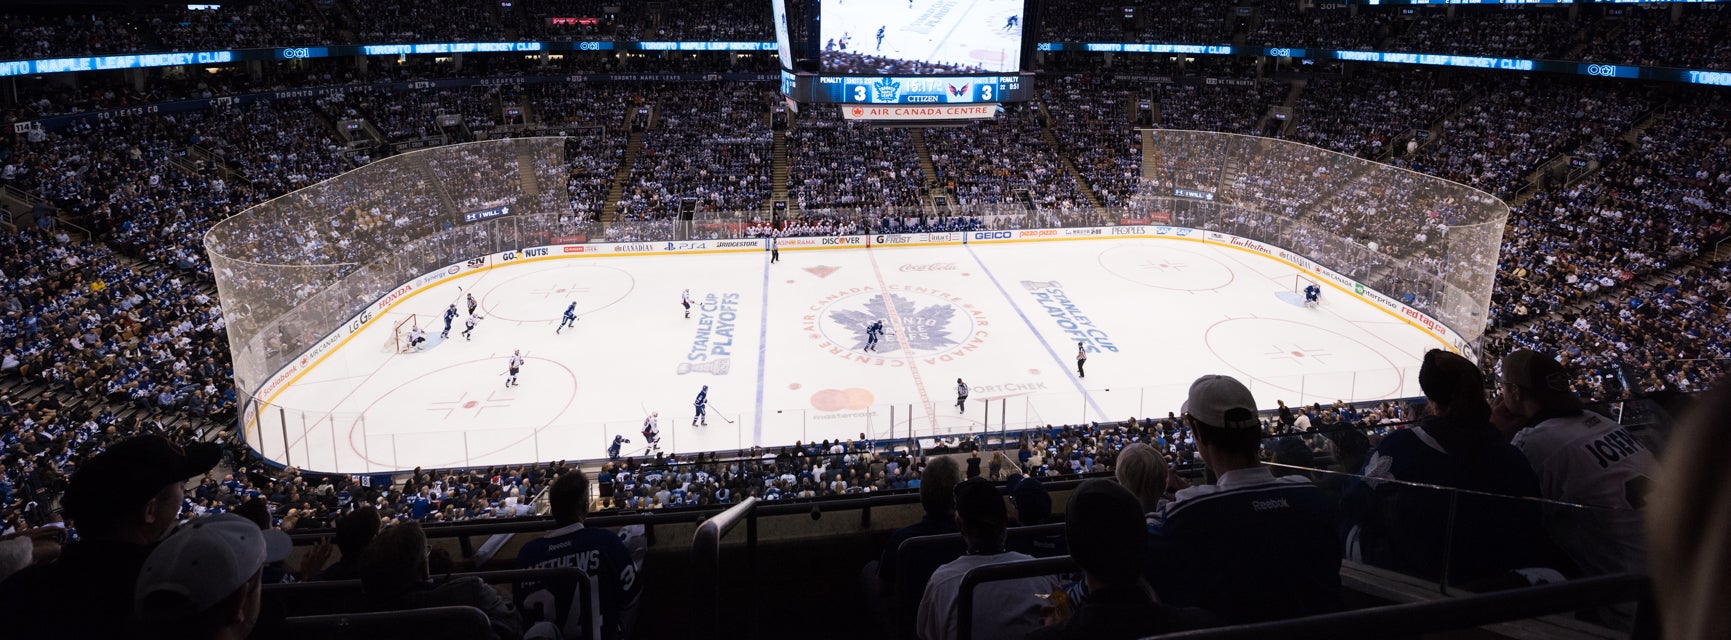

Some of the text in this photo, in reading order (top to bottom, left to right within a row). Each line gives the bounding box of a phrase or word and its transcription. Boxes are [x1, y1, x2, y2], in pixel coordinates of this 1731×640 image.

[364, 42, 540, 54] TORONTO MAPLE LEAF HOCKEY CLUB
[640, 42, 778, 50] TORONTO MAPLE LEAF HOCKEY CLU
[1124, 44, 1150, 52] MAPLE
[1174, 45, 1206, 53] HOCKEY
[1208, 46, 1230, 54] CLUB
[36, 58, 91, 72] MAPLE
[95, 56, 136, 69] LEAF
[139, 53, 194, 66] HOCKEY
[198, 51, 231, 63] CLUB
[1337, 50, 1532, 70] TORONTO MAPLE LEAF HOCKEY CLUB
[854, 86, 866, 101] 3
[982, 85, 992, 100] 3
[16, 123, 30, 132] 114
[975, 231, 1012, 240] GEICO
[1112, 227, 1146, 235] PEOPLES
[1230, 236, 1243, 247] Tim
[1243, 240, 1272, 255] Hortons
[467, 257, 485, 266] SN
[503, 248, 548, 261] GO NUTS!
[898, 262, 958, 272] Coca-Cola
[424, 271, 446, 283] Synergy
[1330, 272, 1352, 287] CANADA
[378, 285, 412, 309] HONDA
[1357, 284, 1397, 309] enterprise
[802, 284, 962, 332] AIR CANADA CENTRE
[687, 293, 718, 361] STANLEY CUP
[711, 292, 740, 356] PLAYOFFS
[1030, 291, 1102, 353] PLAYOFFS
[1045, 288, 1120, 352] STANLEY CUP
[348, 322, 359, 334] LG
[819, 310, 989, 367] AIR CANADA CENTRE
[309, 333, 341, 360] AIR CANADA
[263, 366, 298, 396] Scotiabank
[813, 411, 876, 420] mastercard
[1251, 496, 1290, 512] Reebok
